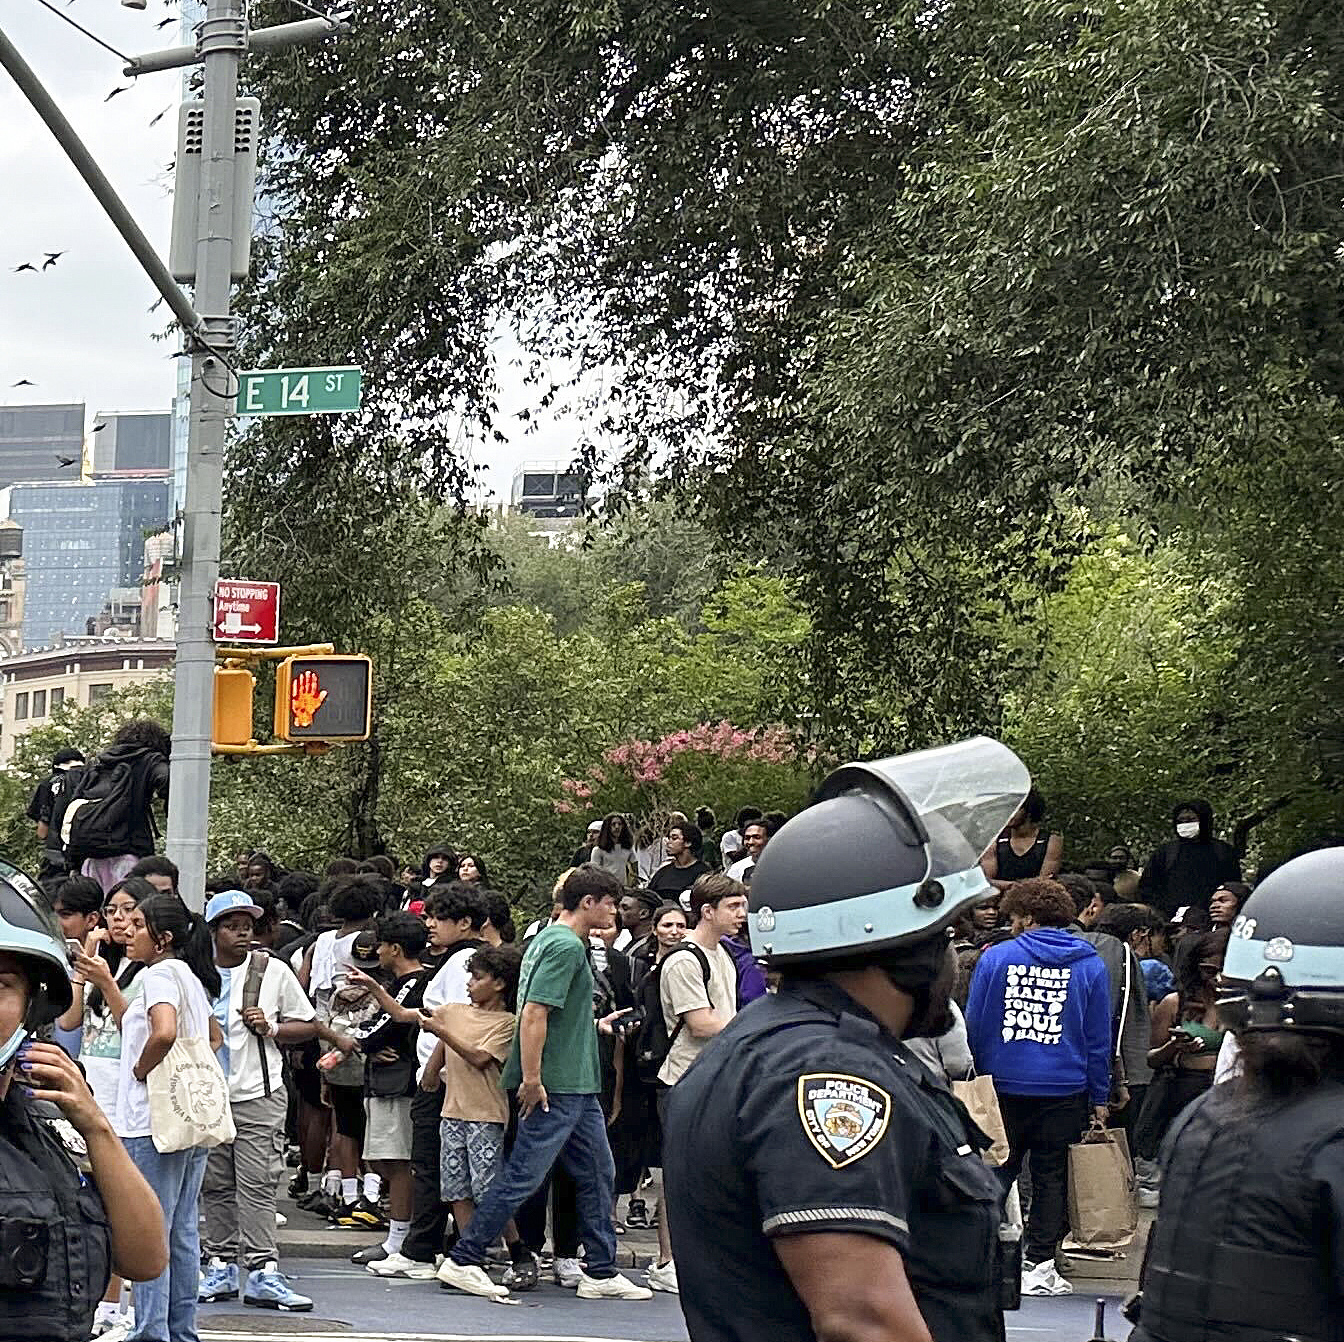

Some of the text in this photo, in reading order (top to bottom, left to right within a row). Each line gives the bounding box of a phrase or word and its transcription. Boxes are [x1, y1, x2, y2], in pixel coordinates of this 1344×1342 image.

[246, 374, 345, 410] E 14 ST
[218, 586, 269, 601] NO STOPPING
[219, 600, 250, 613] Anytime
[1007, 964, 1071, 980] DO MORE
[1020, 977, 1069, 989] OF WHAT
[1005, 986, 1067, 1003] MAKES
[1004, 999, 1045, 1014] YOUR
[1003, 1010, 1062, 1033] SOUL
[1015, 1029, 1062, 1045] HAPPY
[825, 1080, 870, 1097] POLICE
[808, 1088, 883, 1113] DEPARTMENT
